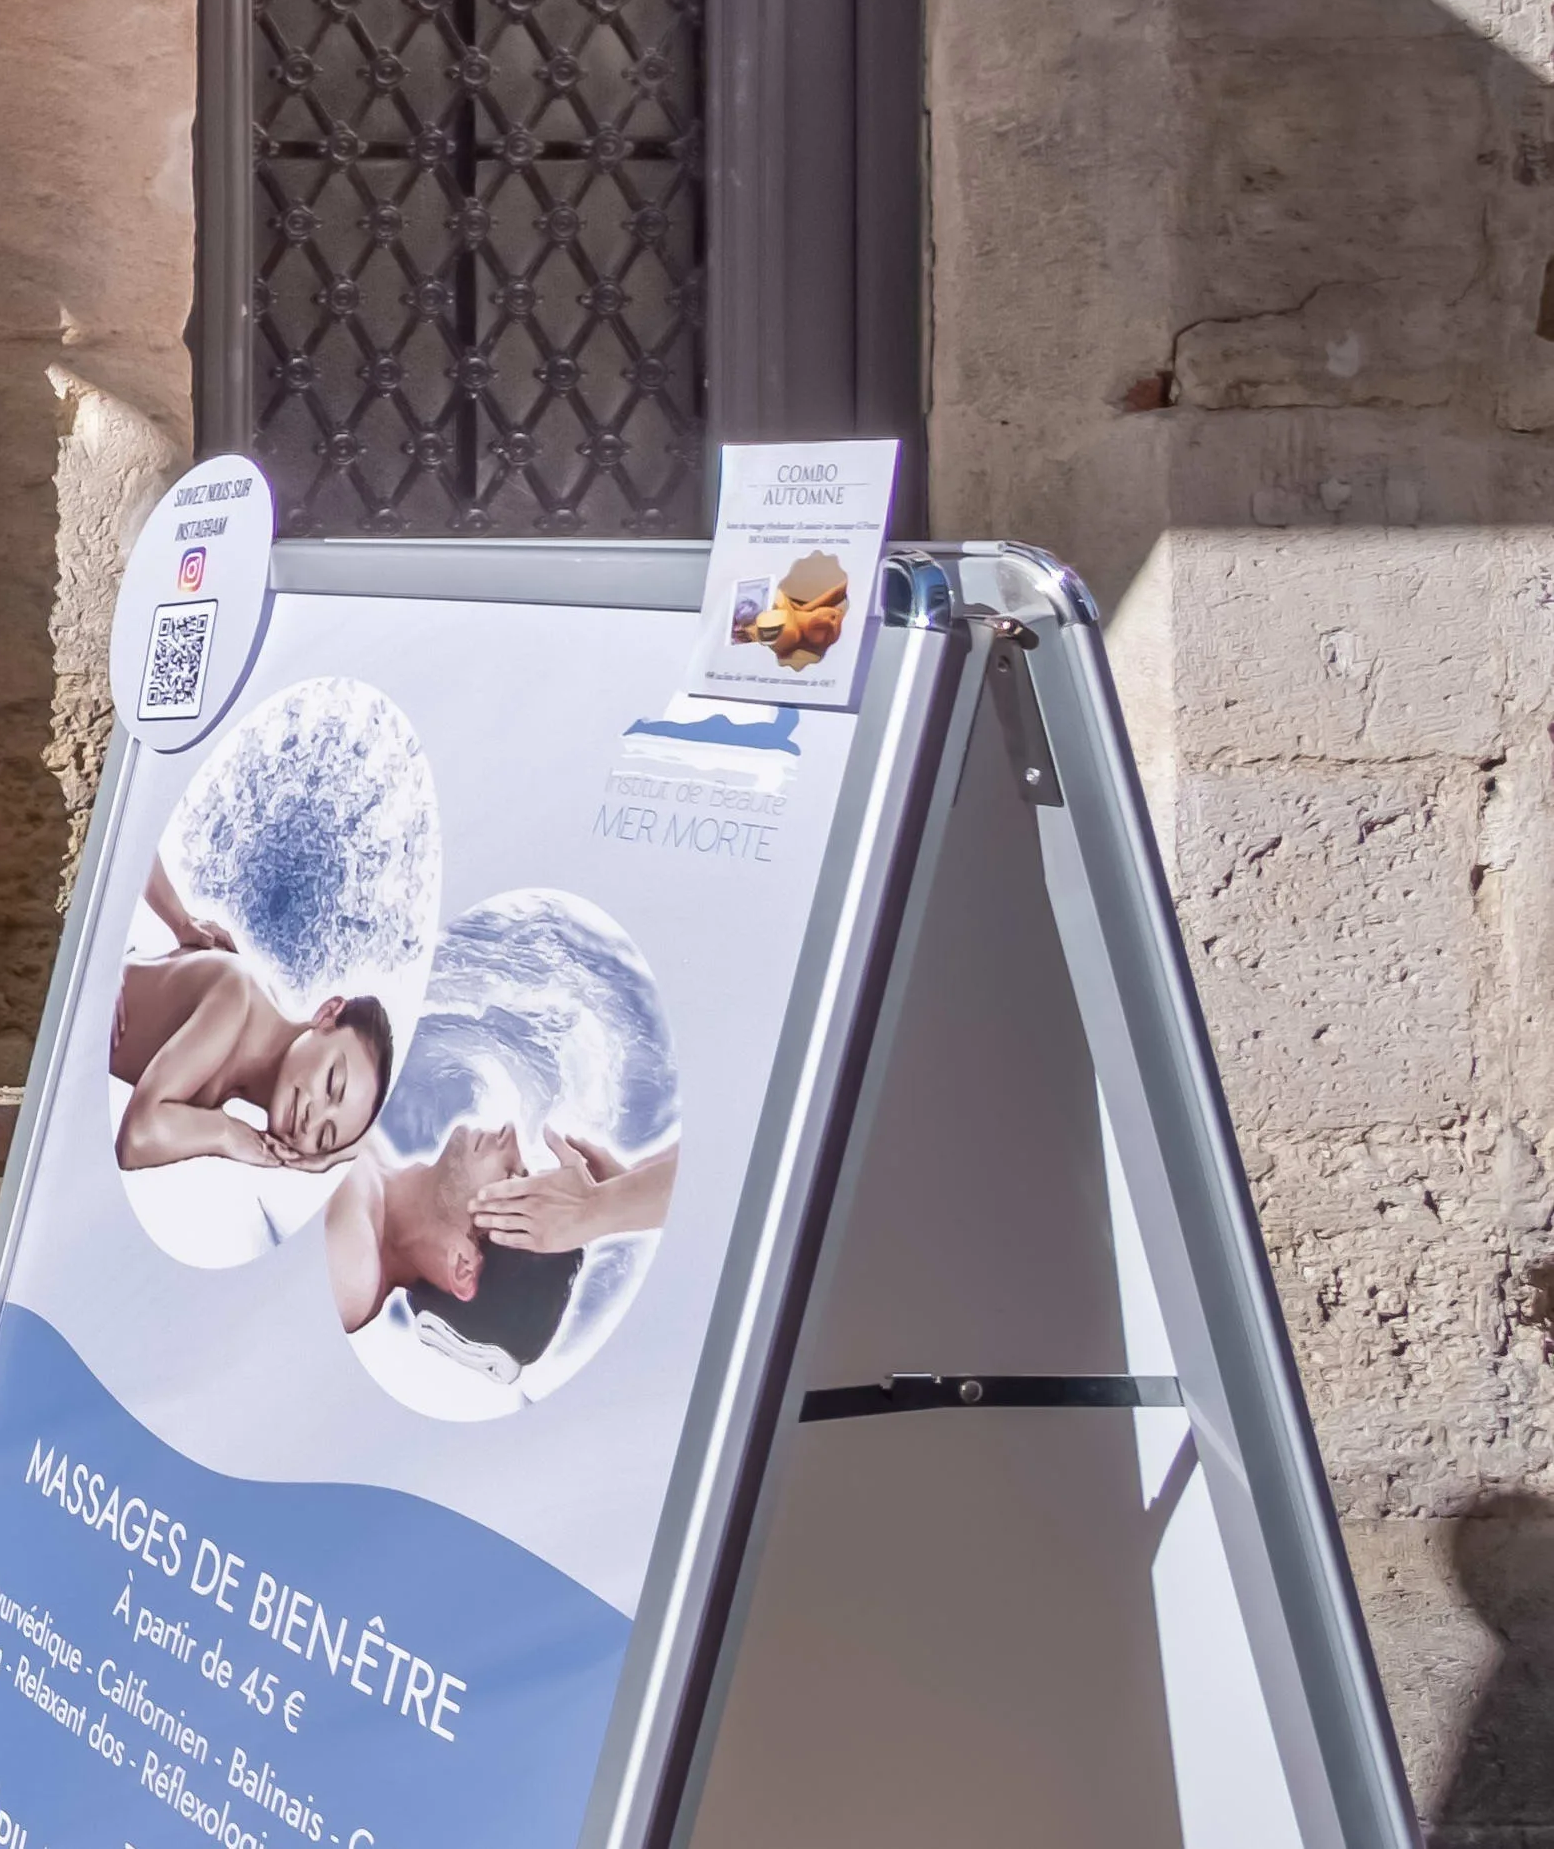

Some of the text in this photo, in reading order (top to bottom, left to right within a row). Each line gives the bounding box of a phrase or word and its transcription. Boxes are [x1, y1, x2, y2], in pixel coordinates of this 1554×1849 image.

[762, 485, 847, 506] AUTOMNE
[776, 463, 838, 484] COMBO
[175, 516, 228, 542] INSTAGRAM
[592, 804, 779, 863] MER MORTE
[24, 1437, 467, 1743] MASSAGES DE BIEN-ÊTRE
[112, 1570, 307, 1735] À partir de 45 €
[12, 1655, 89, 1739] Relaxant
[88, 1712, 126, 1769] dos
[97, 1656, 209, 1766] Californien
[227, 1746, 325, 1842] Balinais
